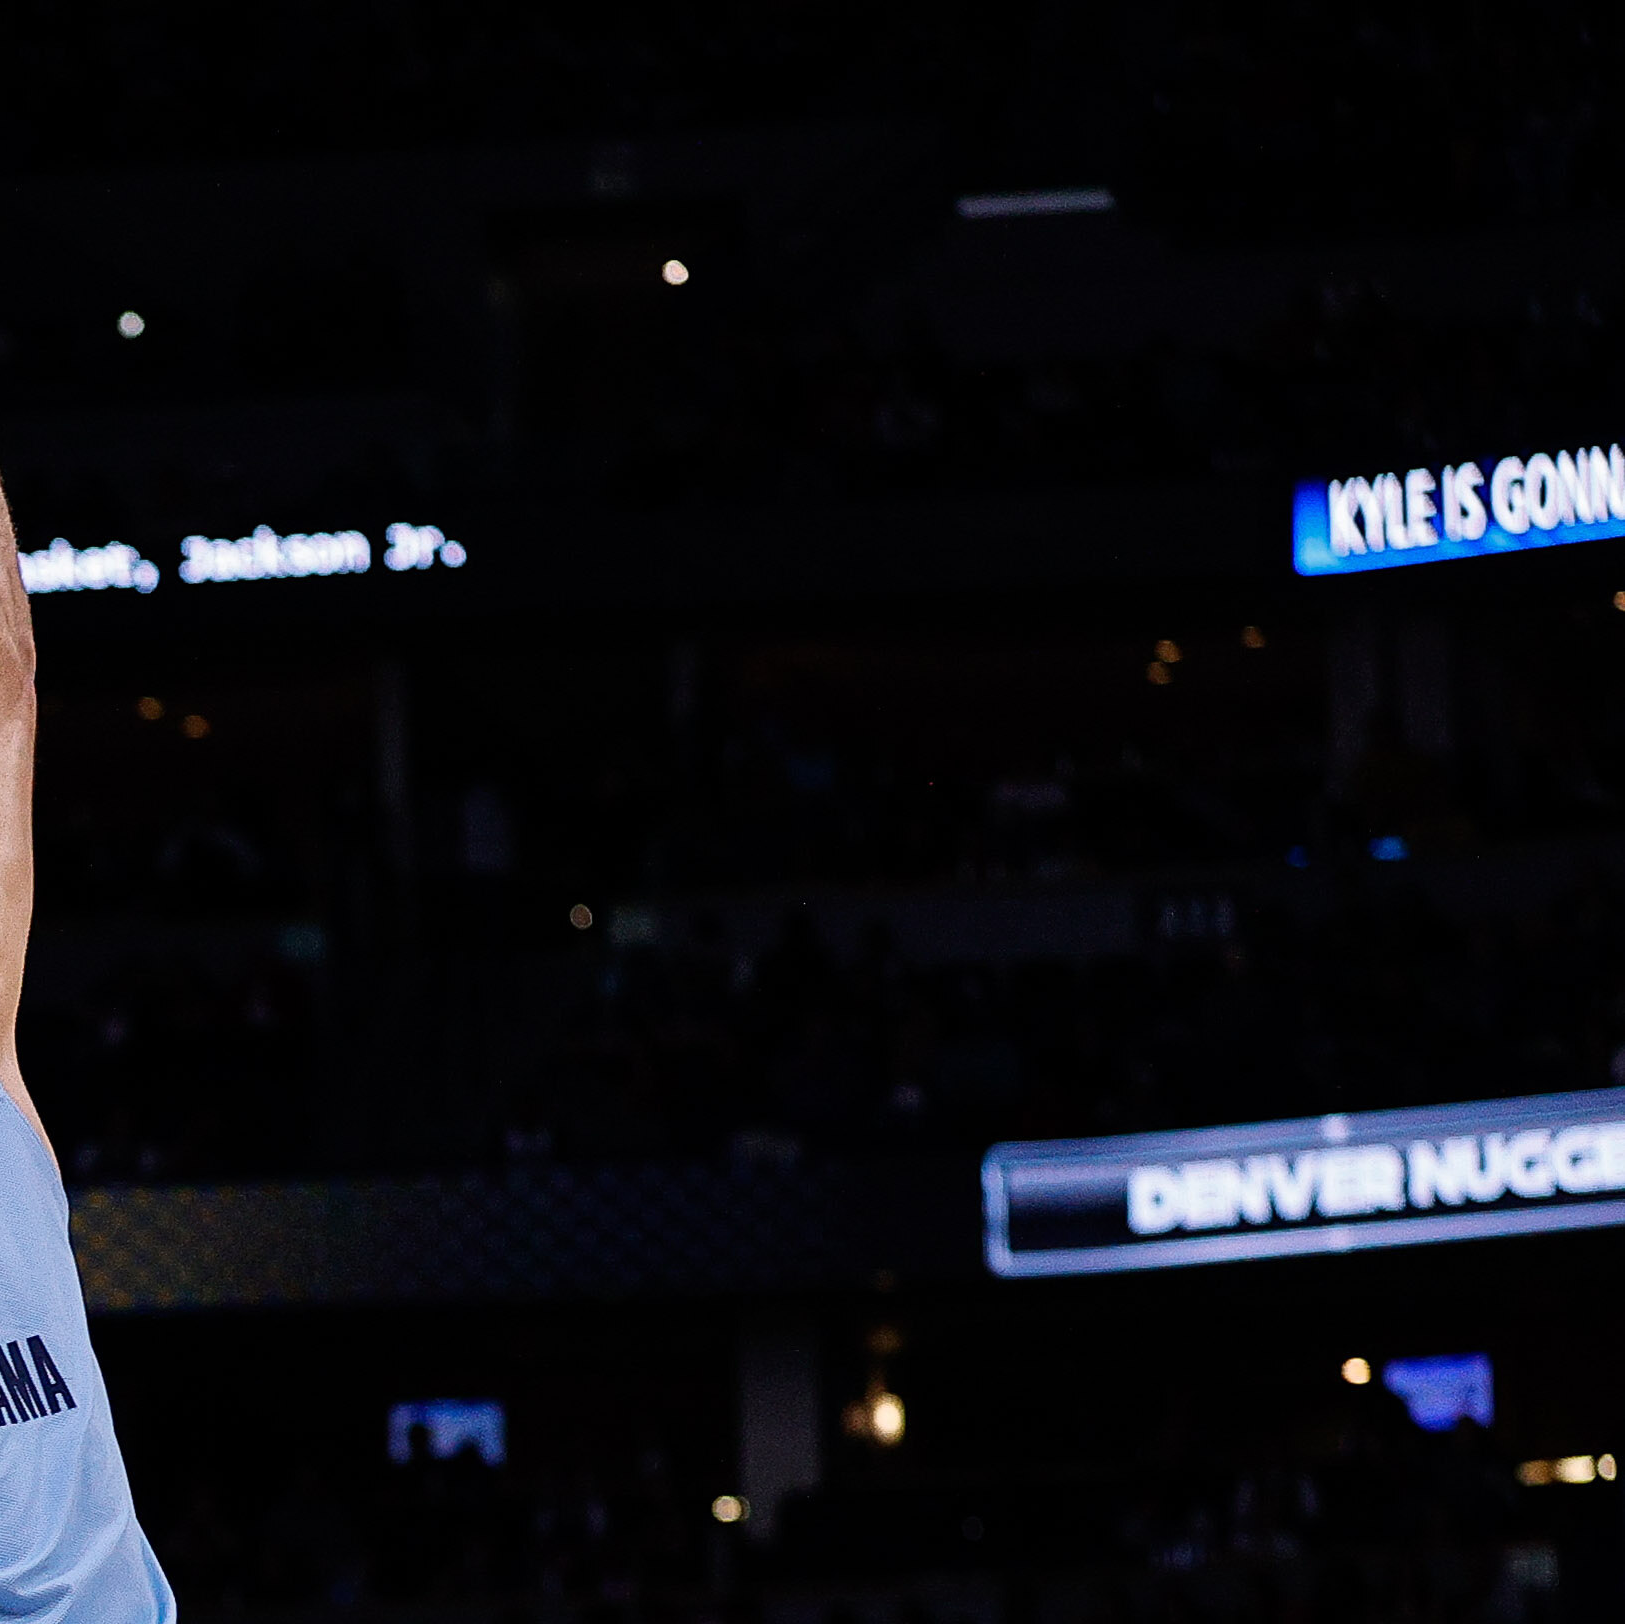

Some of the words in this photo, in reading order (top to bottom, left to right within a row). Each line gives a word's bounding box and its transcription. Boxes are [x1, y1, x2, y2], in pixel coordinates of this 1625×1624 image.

[178, 524, 371, 584] Jackson
[384, 522, 467, 572] Jr.
[1327, 467, 1439, 557] KYLE
[1441, 461, 1488, 543] IS
[1127, 1142, 1406, 1235] DENVER
